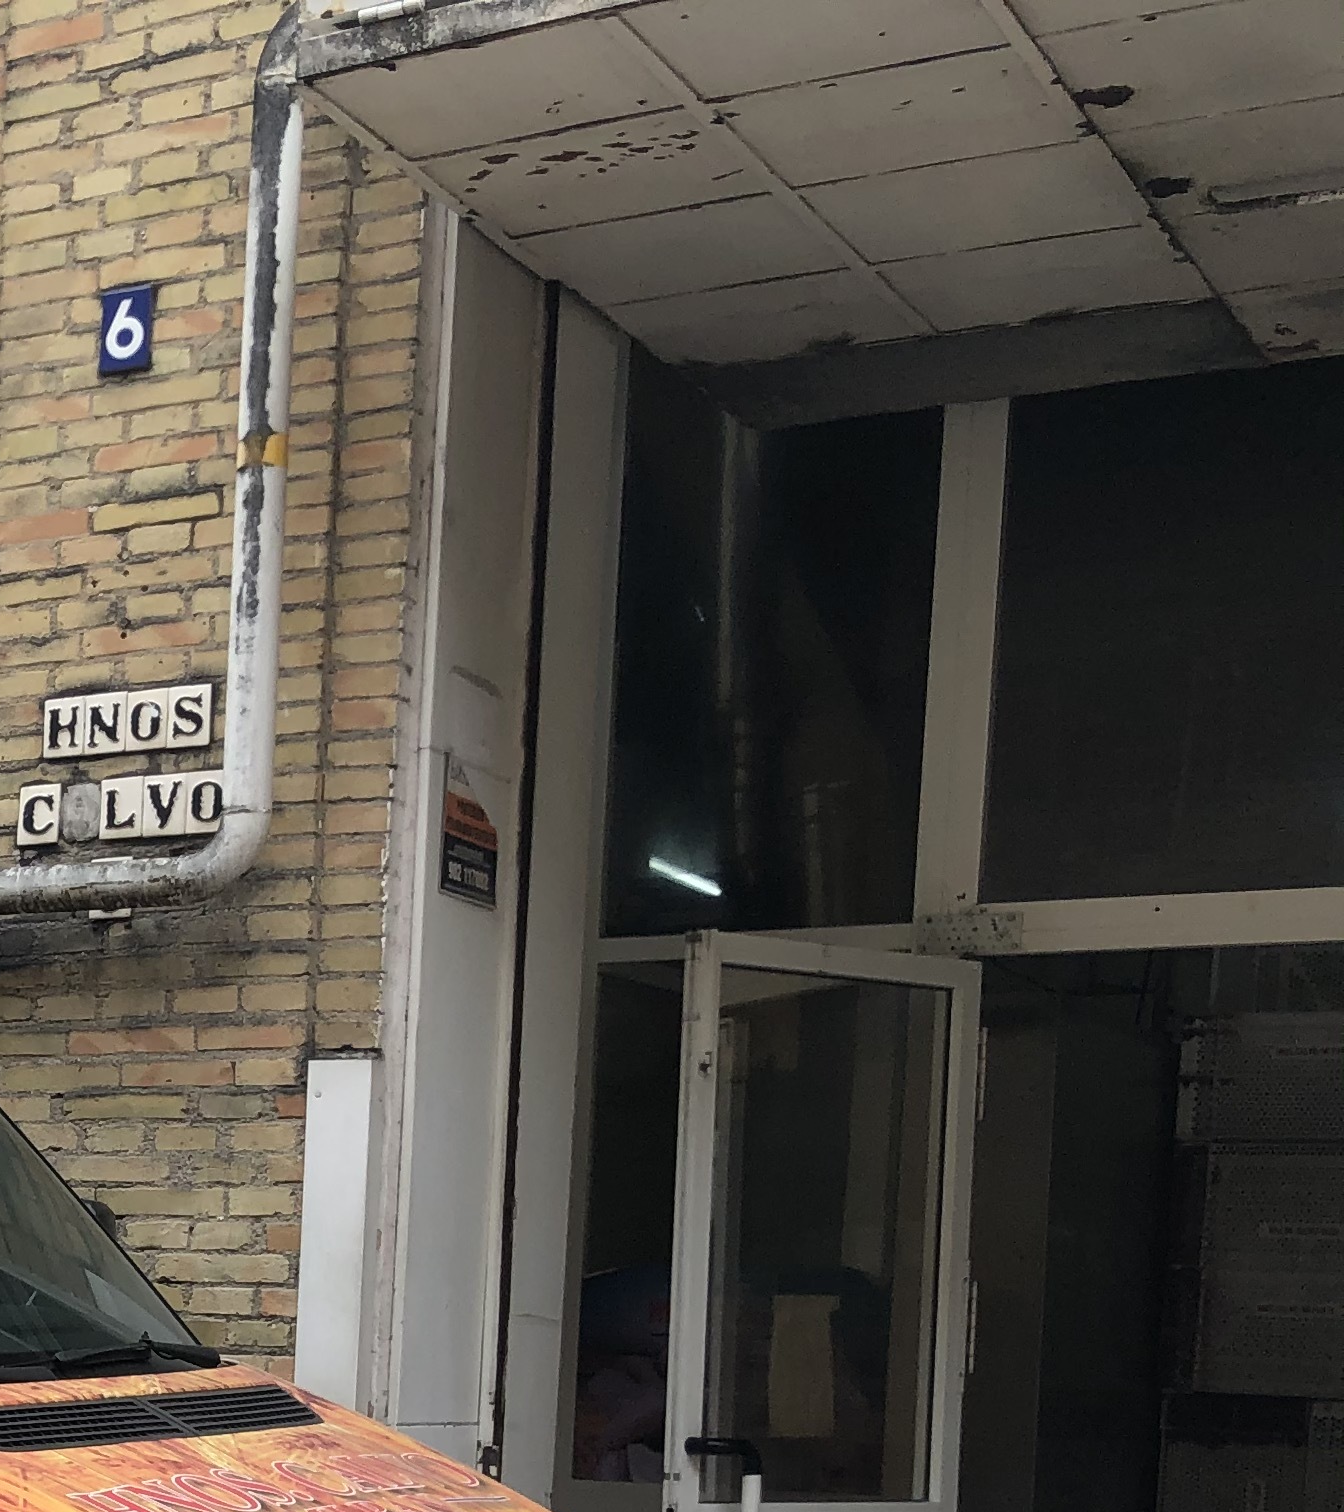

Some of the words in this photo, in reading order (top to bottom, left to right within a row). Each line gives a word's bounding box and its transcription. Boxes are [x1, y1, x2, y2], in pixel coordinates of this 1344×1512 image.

[105, 299, 144, 359] 6
[48, 693, 203, 749] HNOS
[23, 781, 223, 834] CLVO
